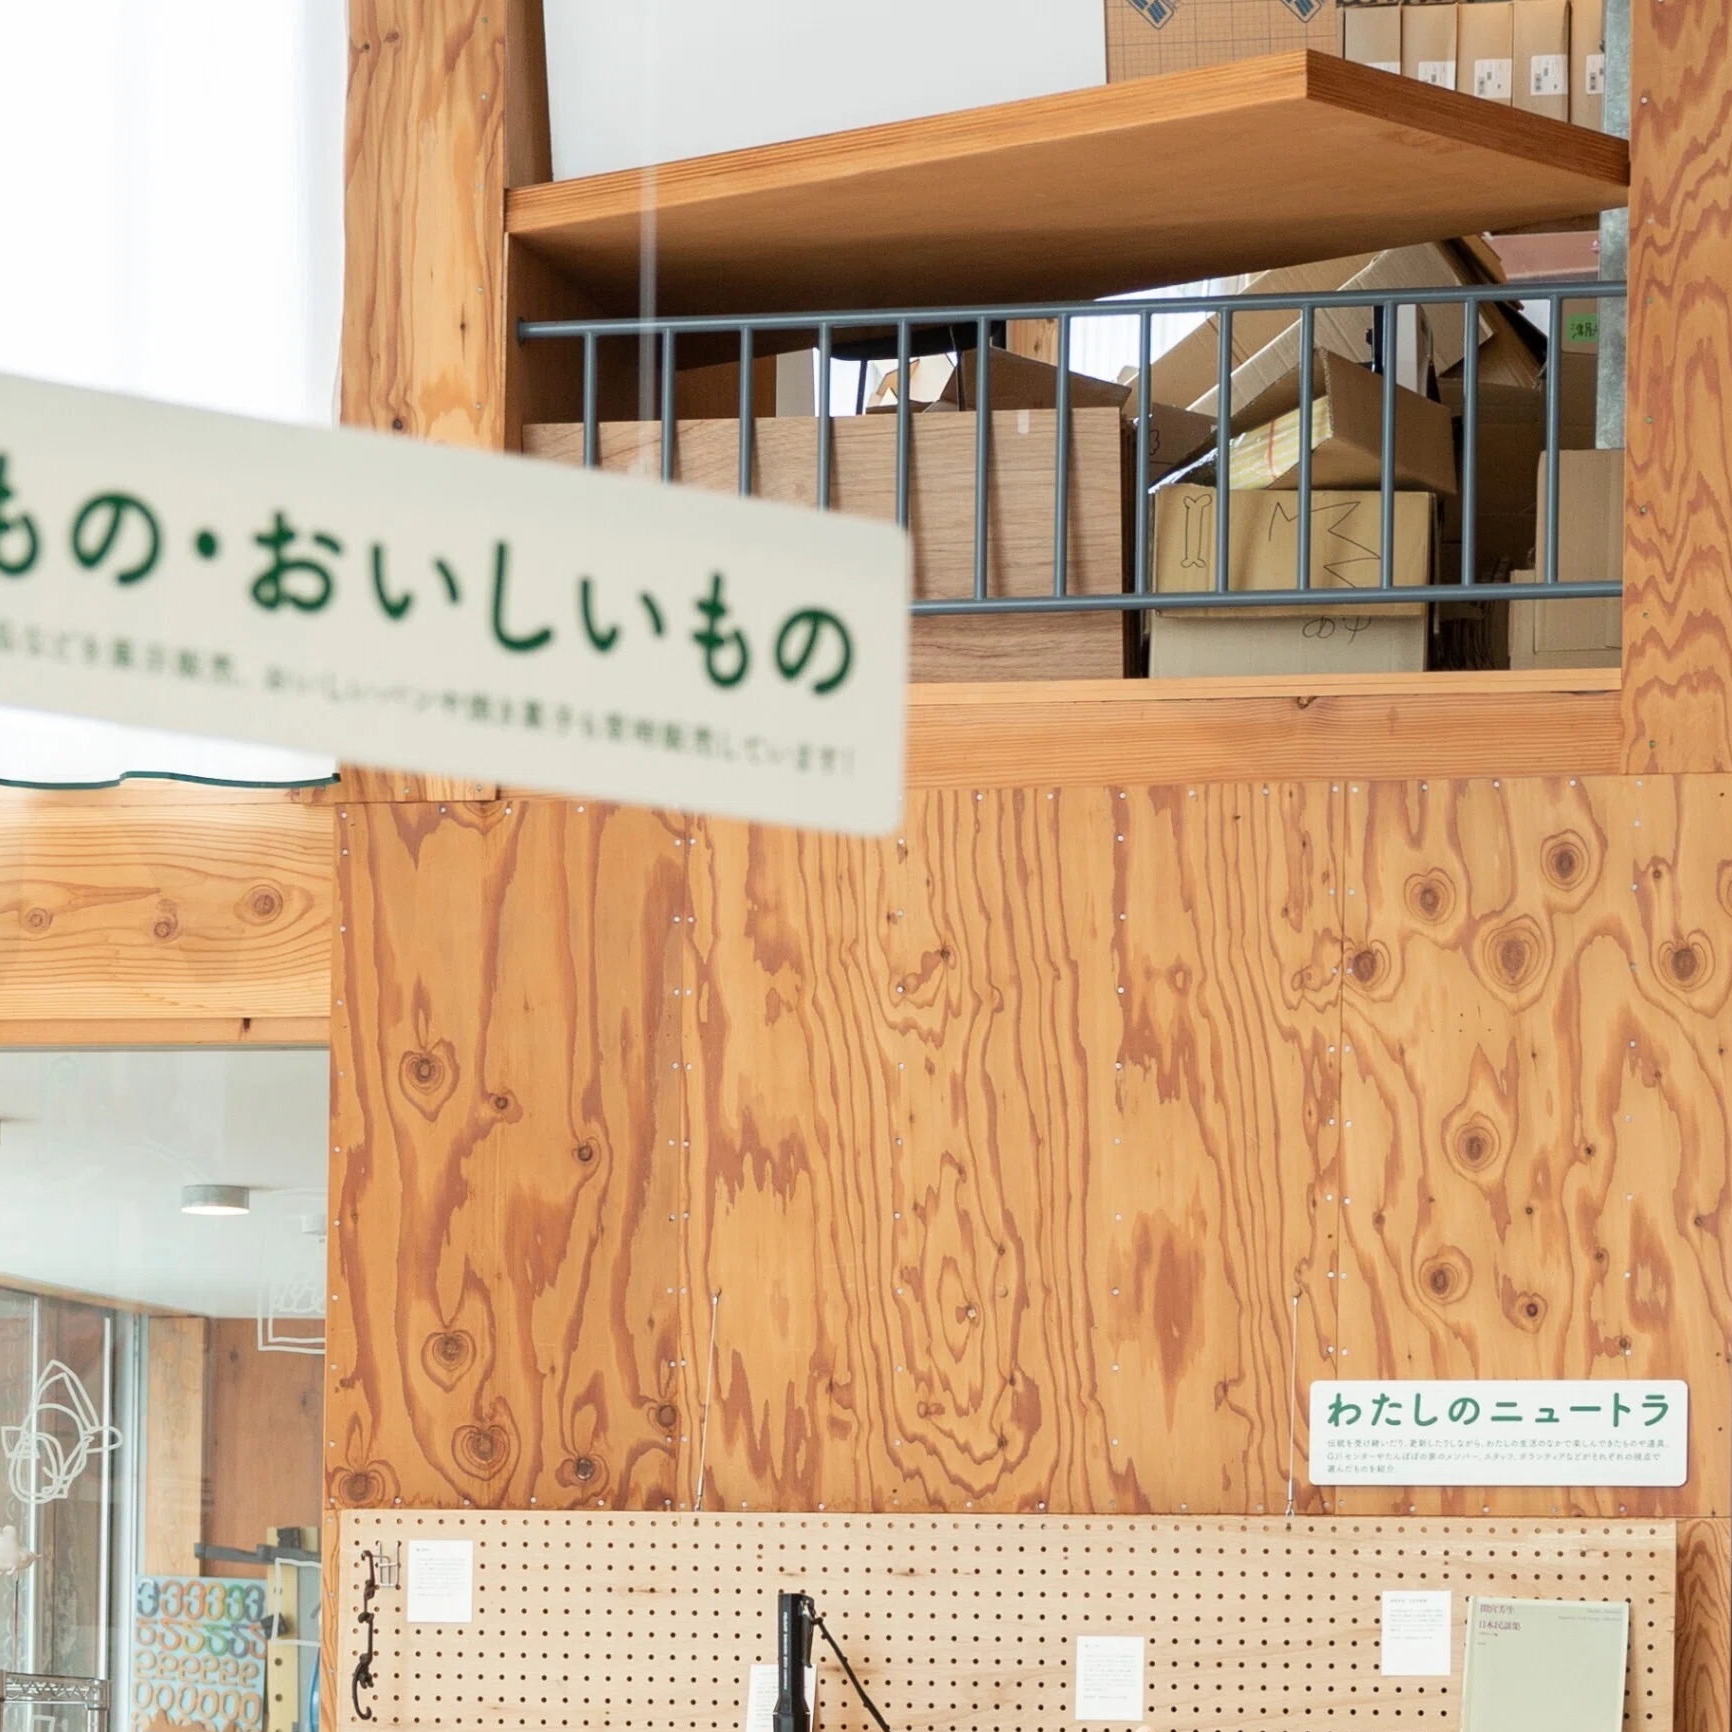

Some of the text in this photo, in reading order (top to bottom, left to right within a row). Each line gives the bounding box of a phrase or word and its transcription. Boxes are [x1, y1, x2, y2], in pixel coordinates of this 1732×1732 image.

[1327, 1392, 1669, 1427] わたしのニュートラ
